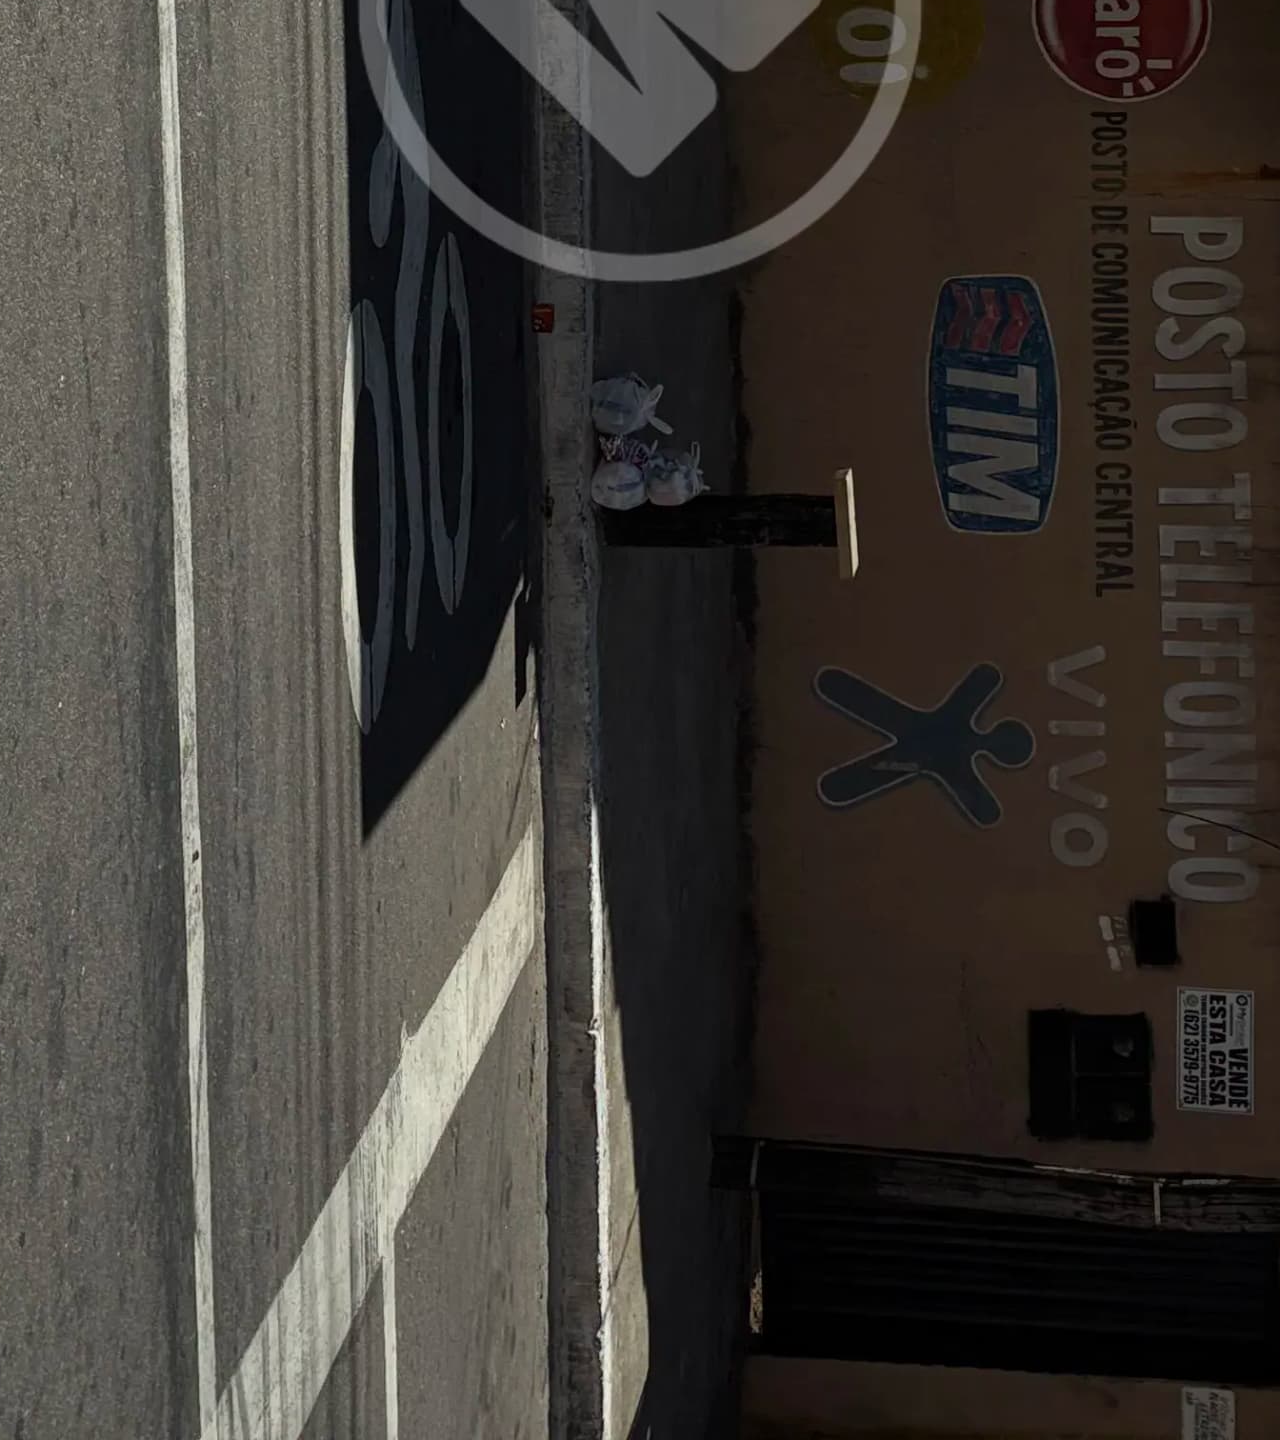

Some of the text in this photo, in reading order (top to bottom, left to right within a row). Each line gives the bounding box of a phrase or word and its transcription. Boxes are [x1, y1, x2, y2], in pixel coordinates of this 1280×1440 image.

[1086, 111, 1138, 599] POSTO DE COMUNICAÇÃO CENTRAL
[944, 362, 1041, 523] TIM
[1149, 214, 1261, 904] POSTO TELEFONICO
[1047, 645, 1110, 869] VIVO
[1182, 1009, 1199, 1106] (62) 3579-9775
[1209, 994, 1227, 1107] ESTA CASA
[1228, 1047, 1249, 1109] VENDE
